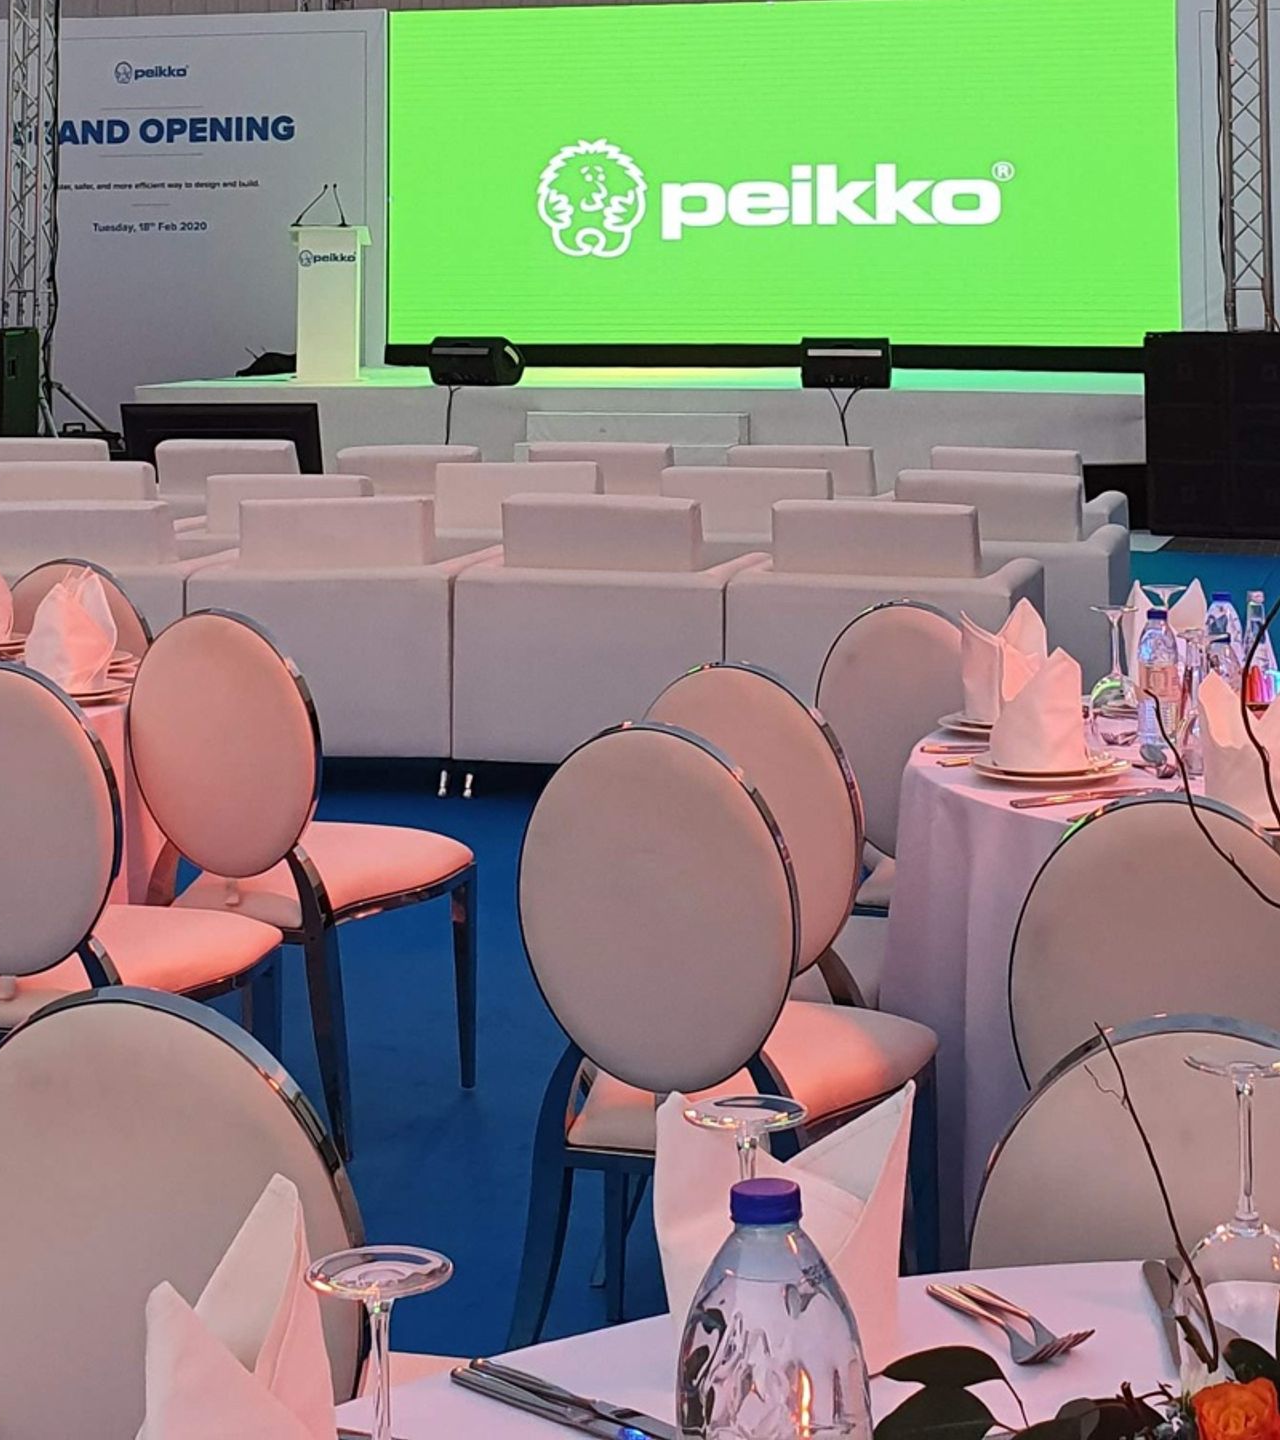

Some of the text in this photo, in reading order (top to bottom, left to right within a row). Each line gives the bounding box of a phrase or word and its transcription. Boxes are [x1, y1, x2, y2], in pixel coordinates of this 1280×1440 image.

[139, 116, 295, 144] OPENING
[93, 222, 136, 233] Tuesday,
[158, 221, 177, 231] Feb
[179, 220, 208, 231] 2020
